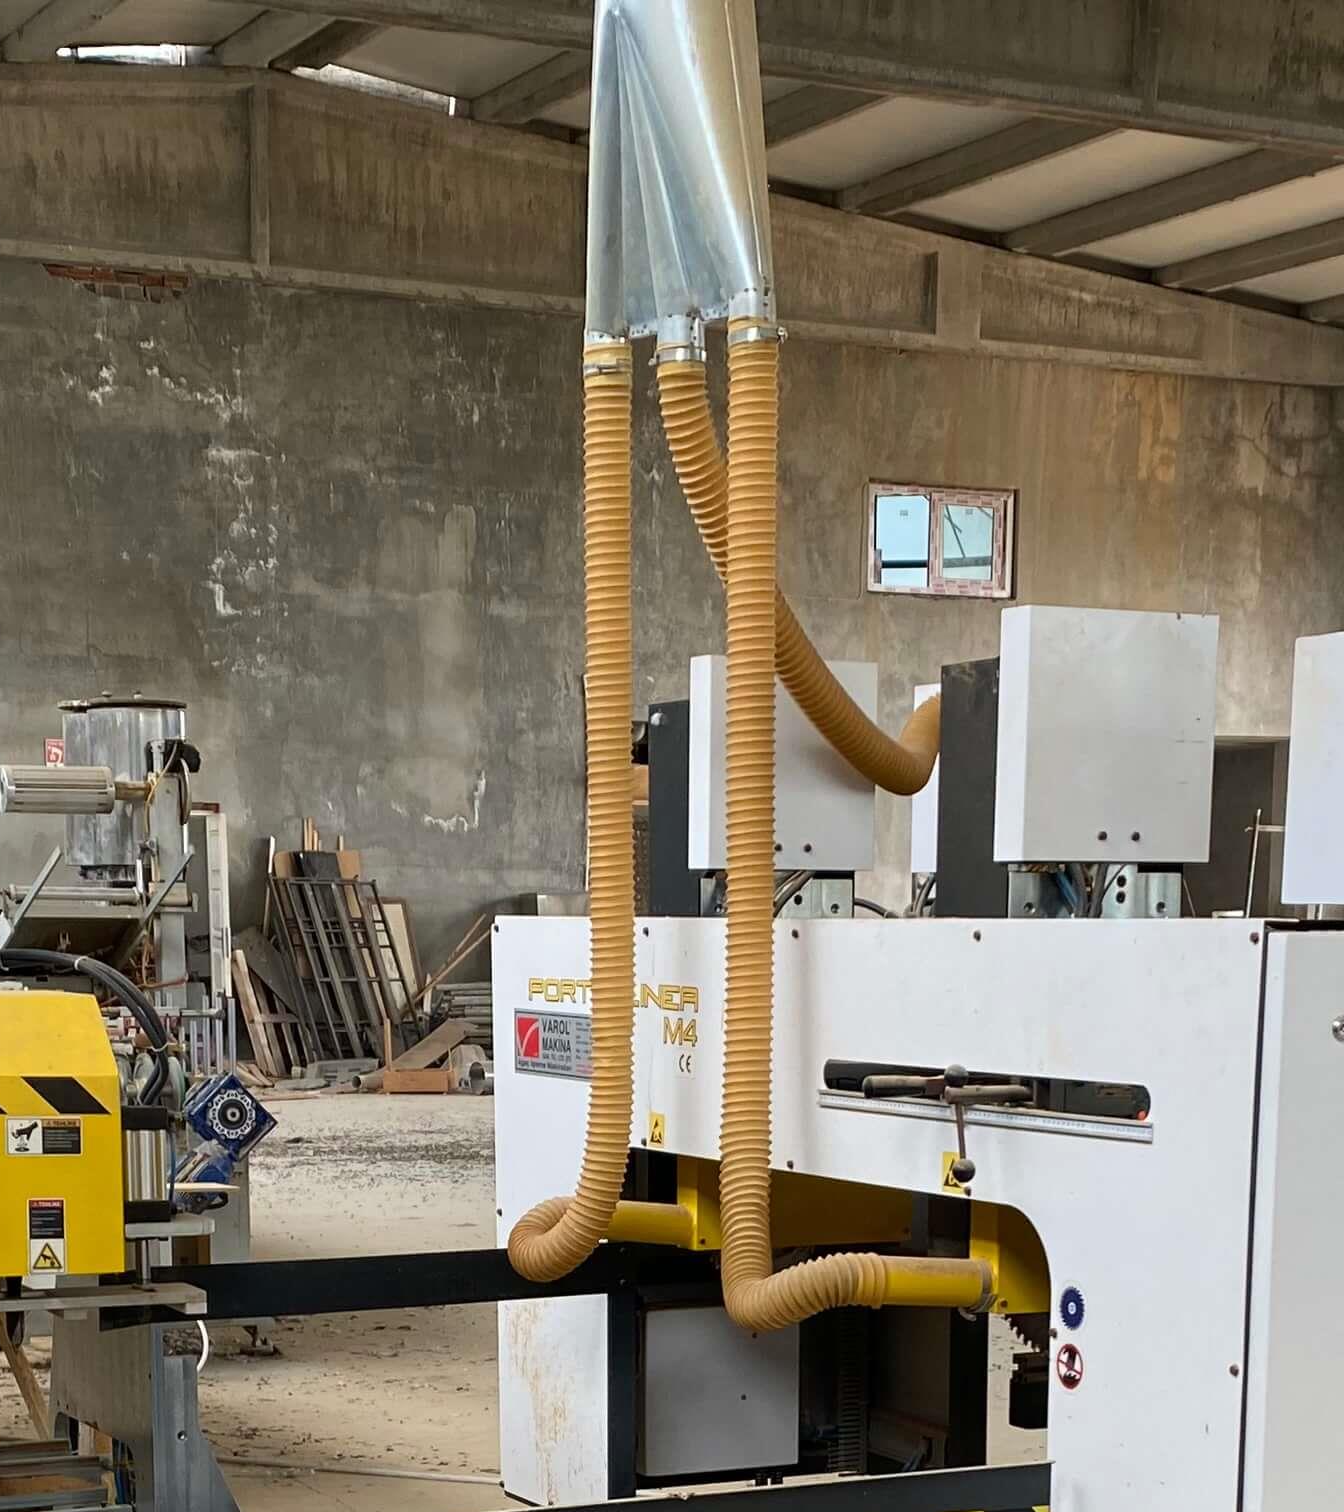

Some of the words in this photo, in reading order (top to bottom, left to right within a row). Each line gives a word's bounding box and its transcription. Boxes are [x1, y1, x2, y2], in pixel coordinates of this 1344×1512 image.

[528, 977, 592, 1004] PORT
[633, 983, 699, 1013] INEA
[541, 1018, 570, 1035] VAROL
[663, 1016, 698, 1048] M4
